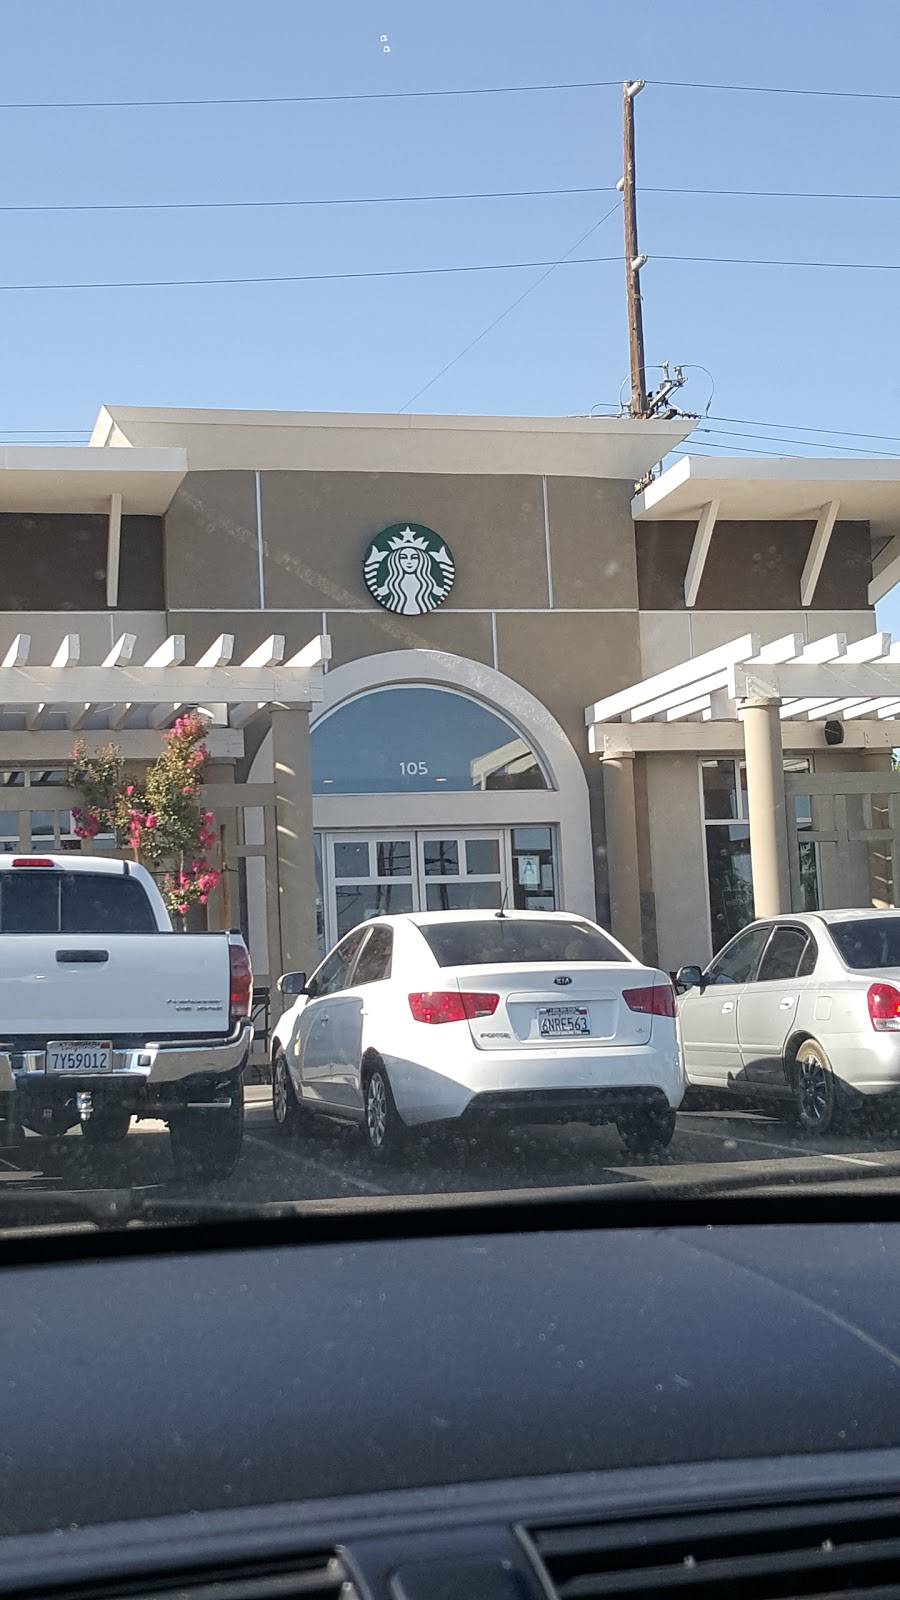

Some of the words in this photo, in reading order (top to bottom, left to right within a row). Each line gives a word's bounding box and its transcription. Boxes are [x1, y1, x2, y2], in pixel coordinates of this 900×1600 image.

[399, 761, 429, 776] 105
[555, 977, 571, 985] KIA
[542, 1017, 588, 1031] 6NRE563
[51, 1053, 108, 1069] 7Y59012
